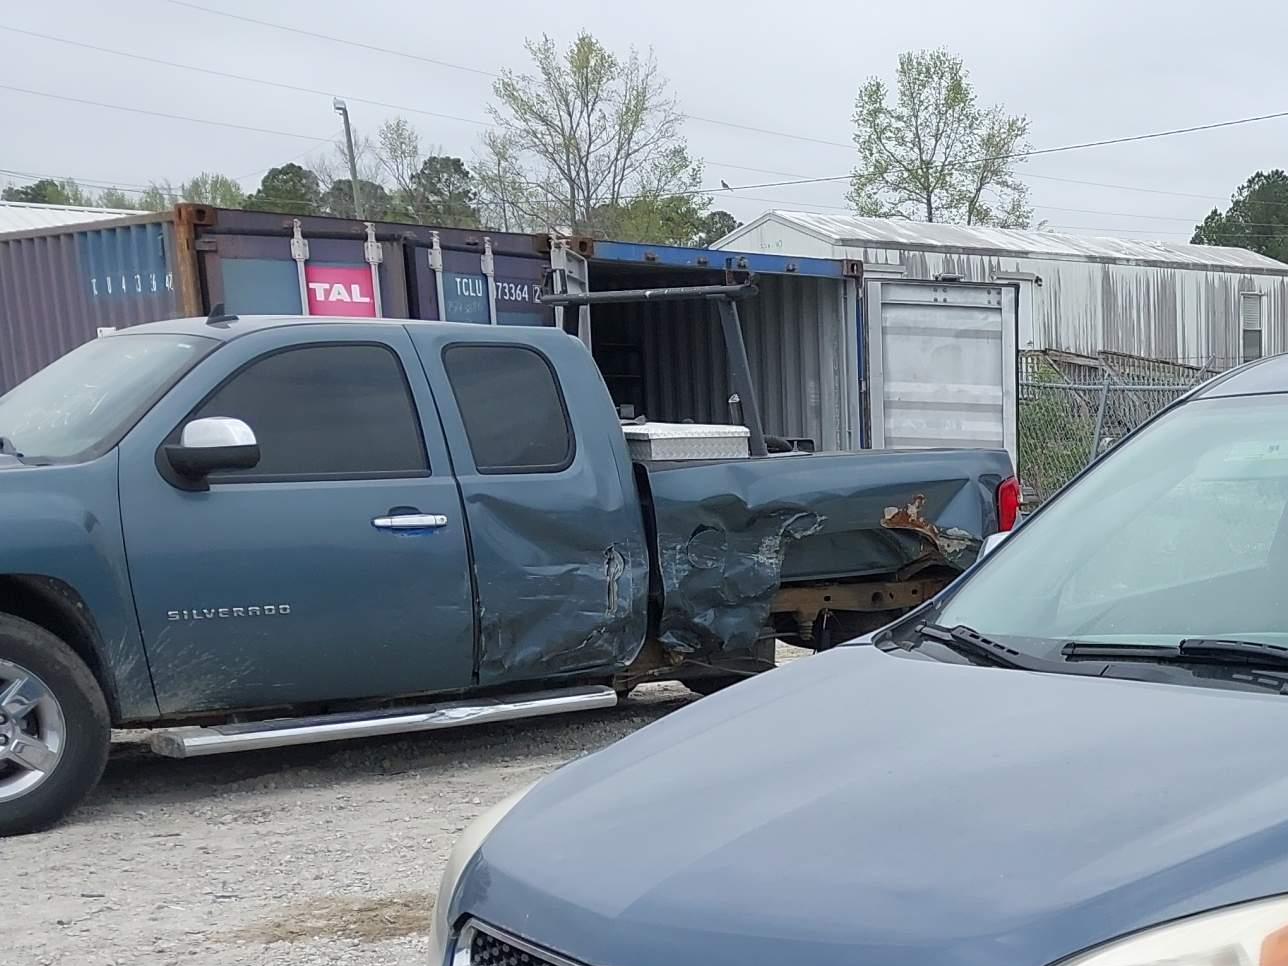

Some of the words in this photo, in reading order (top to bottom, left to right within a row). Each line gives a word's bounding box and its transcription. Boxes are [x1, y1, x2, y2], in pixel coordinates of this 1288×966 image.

[308, 282, 371, 303] TAL
[455, 277, 483, 297] TCLU
[493, 282, 529, 302] 73364
[167, 604, 290, 620] SILVERADO
